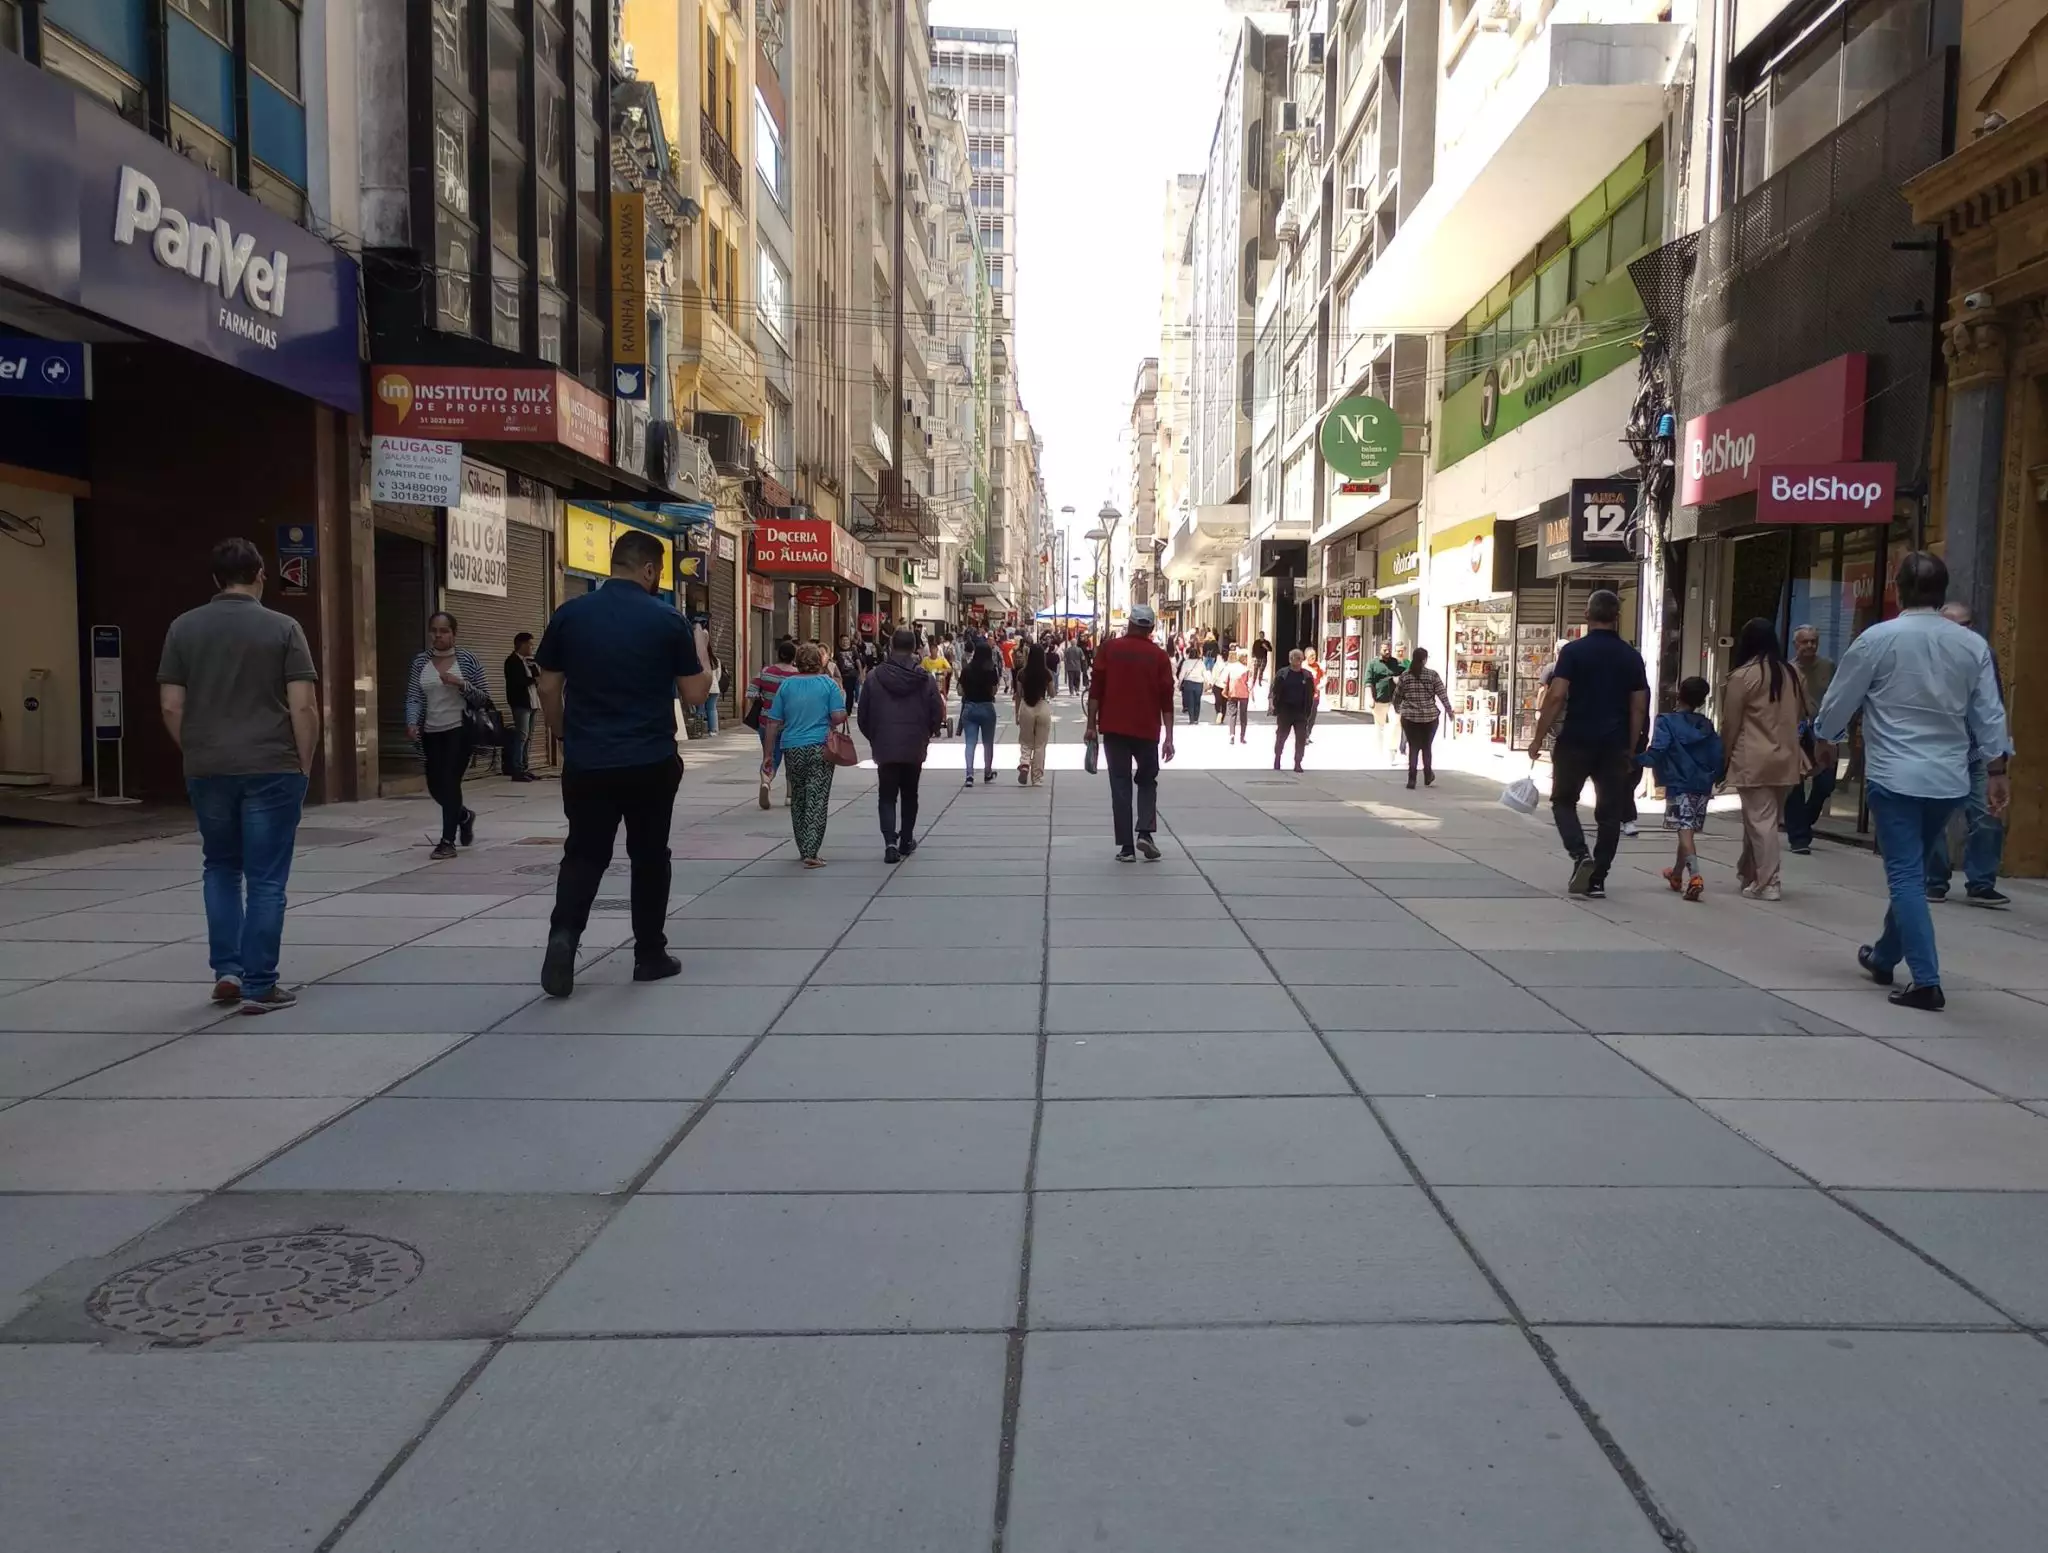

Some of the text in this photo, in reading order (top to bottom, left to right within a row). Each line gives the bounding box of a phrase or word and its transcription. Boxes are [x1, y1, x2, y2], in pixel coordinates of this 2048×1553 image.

[115, 164, 288, 317] PanVel
[619, 203, 635, 353] RAINHA DAS NOIVAS
[219, 307, 278, 350] FARMÁCIAS
[1500, 306, 1582, 396] ODONTO
[414, 385, 549, 403] INSTITUTO MIX
[415, 402, 435, 411] DE
[446, 403, 552, 415] PROFISSÕES
[1337, 414, 1379, 444] NC
[381, 438, 453, 455] ALUGA-SE
[1692, 428, 1755, 480] BelShop
[377, 468, 384, 477] A
[385, 468, 416, 479] PARTIR
[418, 472, 431, 481] DE
[391, 481, 448, 495] 33489099
[1583, 492, 1625, 504] BANCA
[1772, 475, 1882, 509] BelShop
[450, 516, 506, 557] ALUGA
[1583, 505, 1626, 541] 12
[453, 551, 507, 587] 99732 9978
[758, 547, 828, 563] DO ALEMÃO
